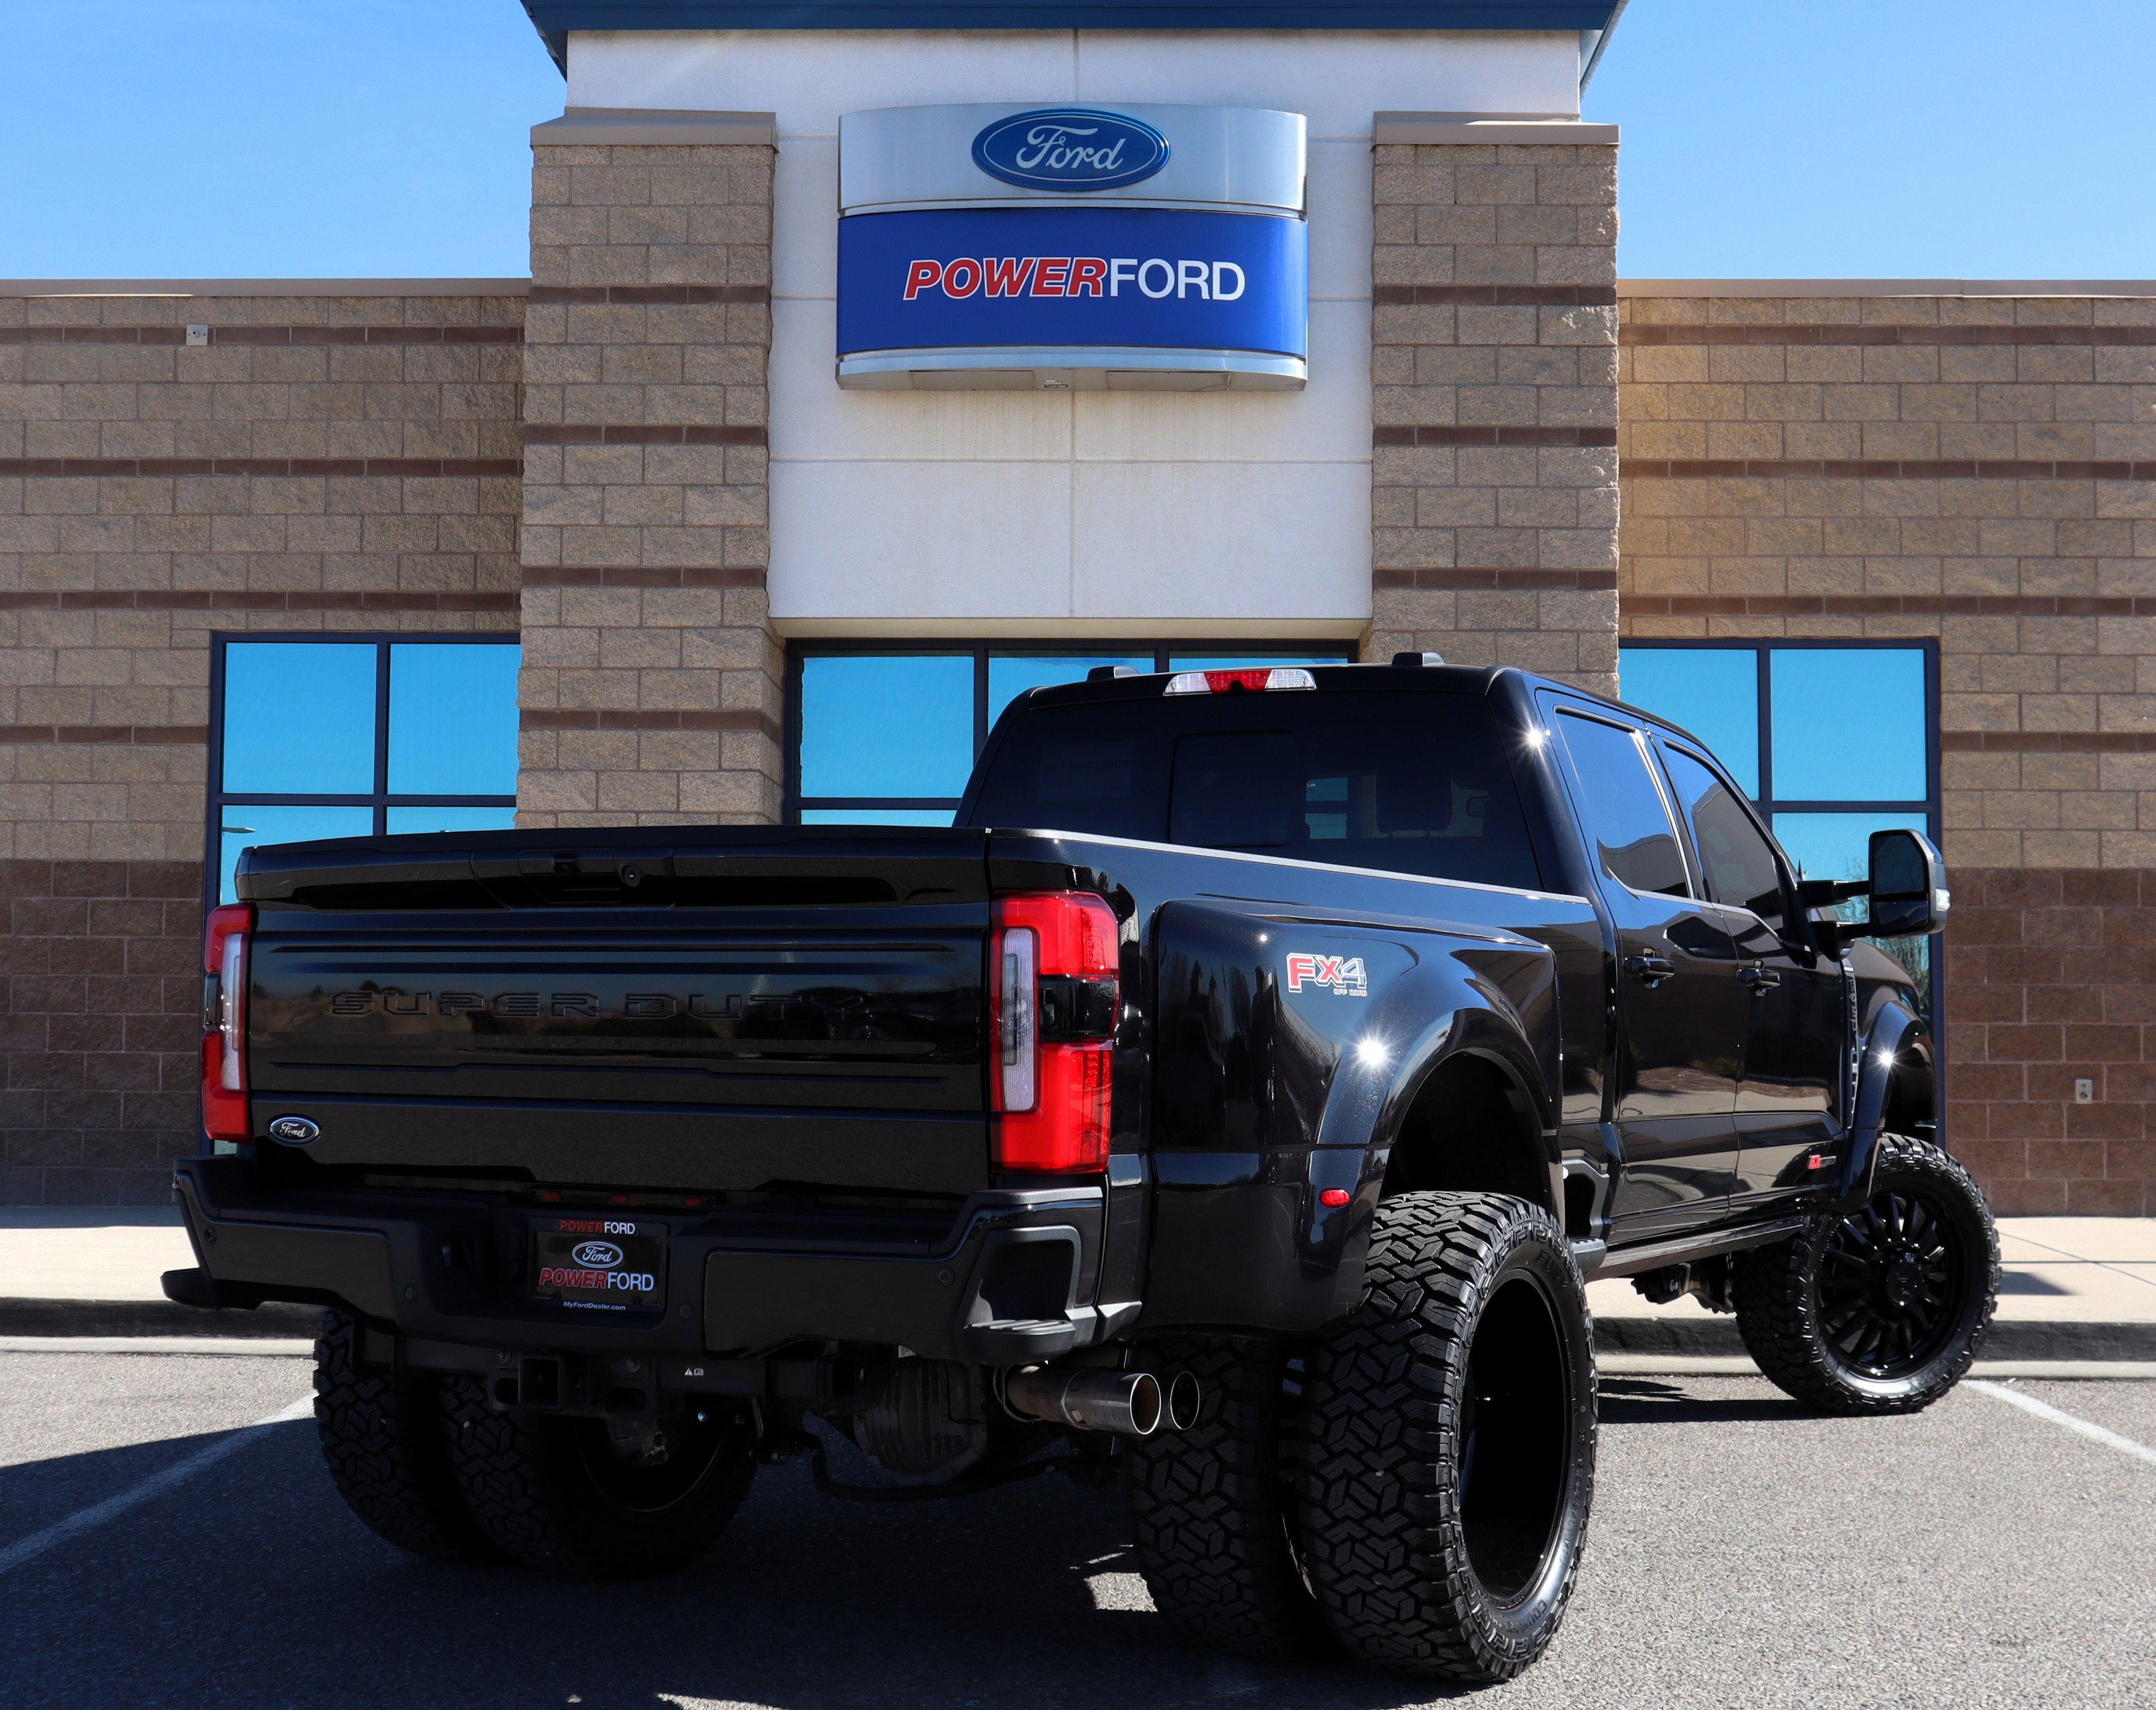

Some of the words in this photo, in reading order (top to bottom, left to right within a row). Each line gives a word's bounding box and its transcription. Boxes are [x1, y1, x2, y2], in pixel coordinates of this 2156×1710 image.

[1016, 124, 1126, 170] Ford
[903, 257, 1245, 301] POWERFORD
[1286, 952, 1368, 993] FX4
[331, 991, 601, 1018] SUPER
[624, 992, 864, 1021] DUTY
[279, 1122, 306, 1138] Ford
[559, 1220, 636, 1235] POWERFORD
[582, 1245, 613, 1263] Ford
[539, 1267, 654, 1292] POWERFORD
[563, 1300, 626, 1311] MyFordDealer.com
